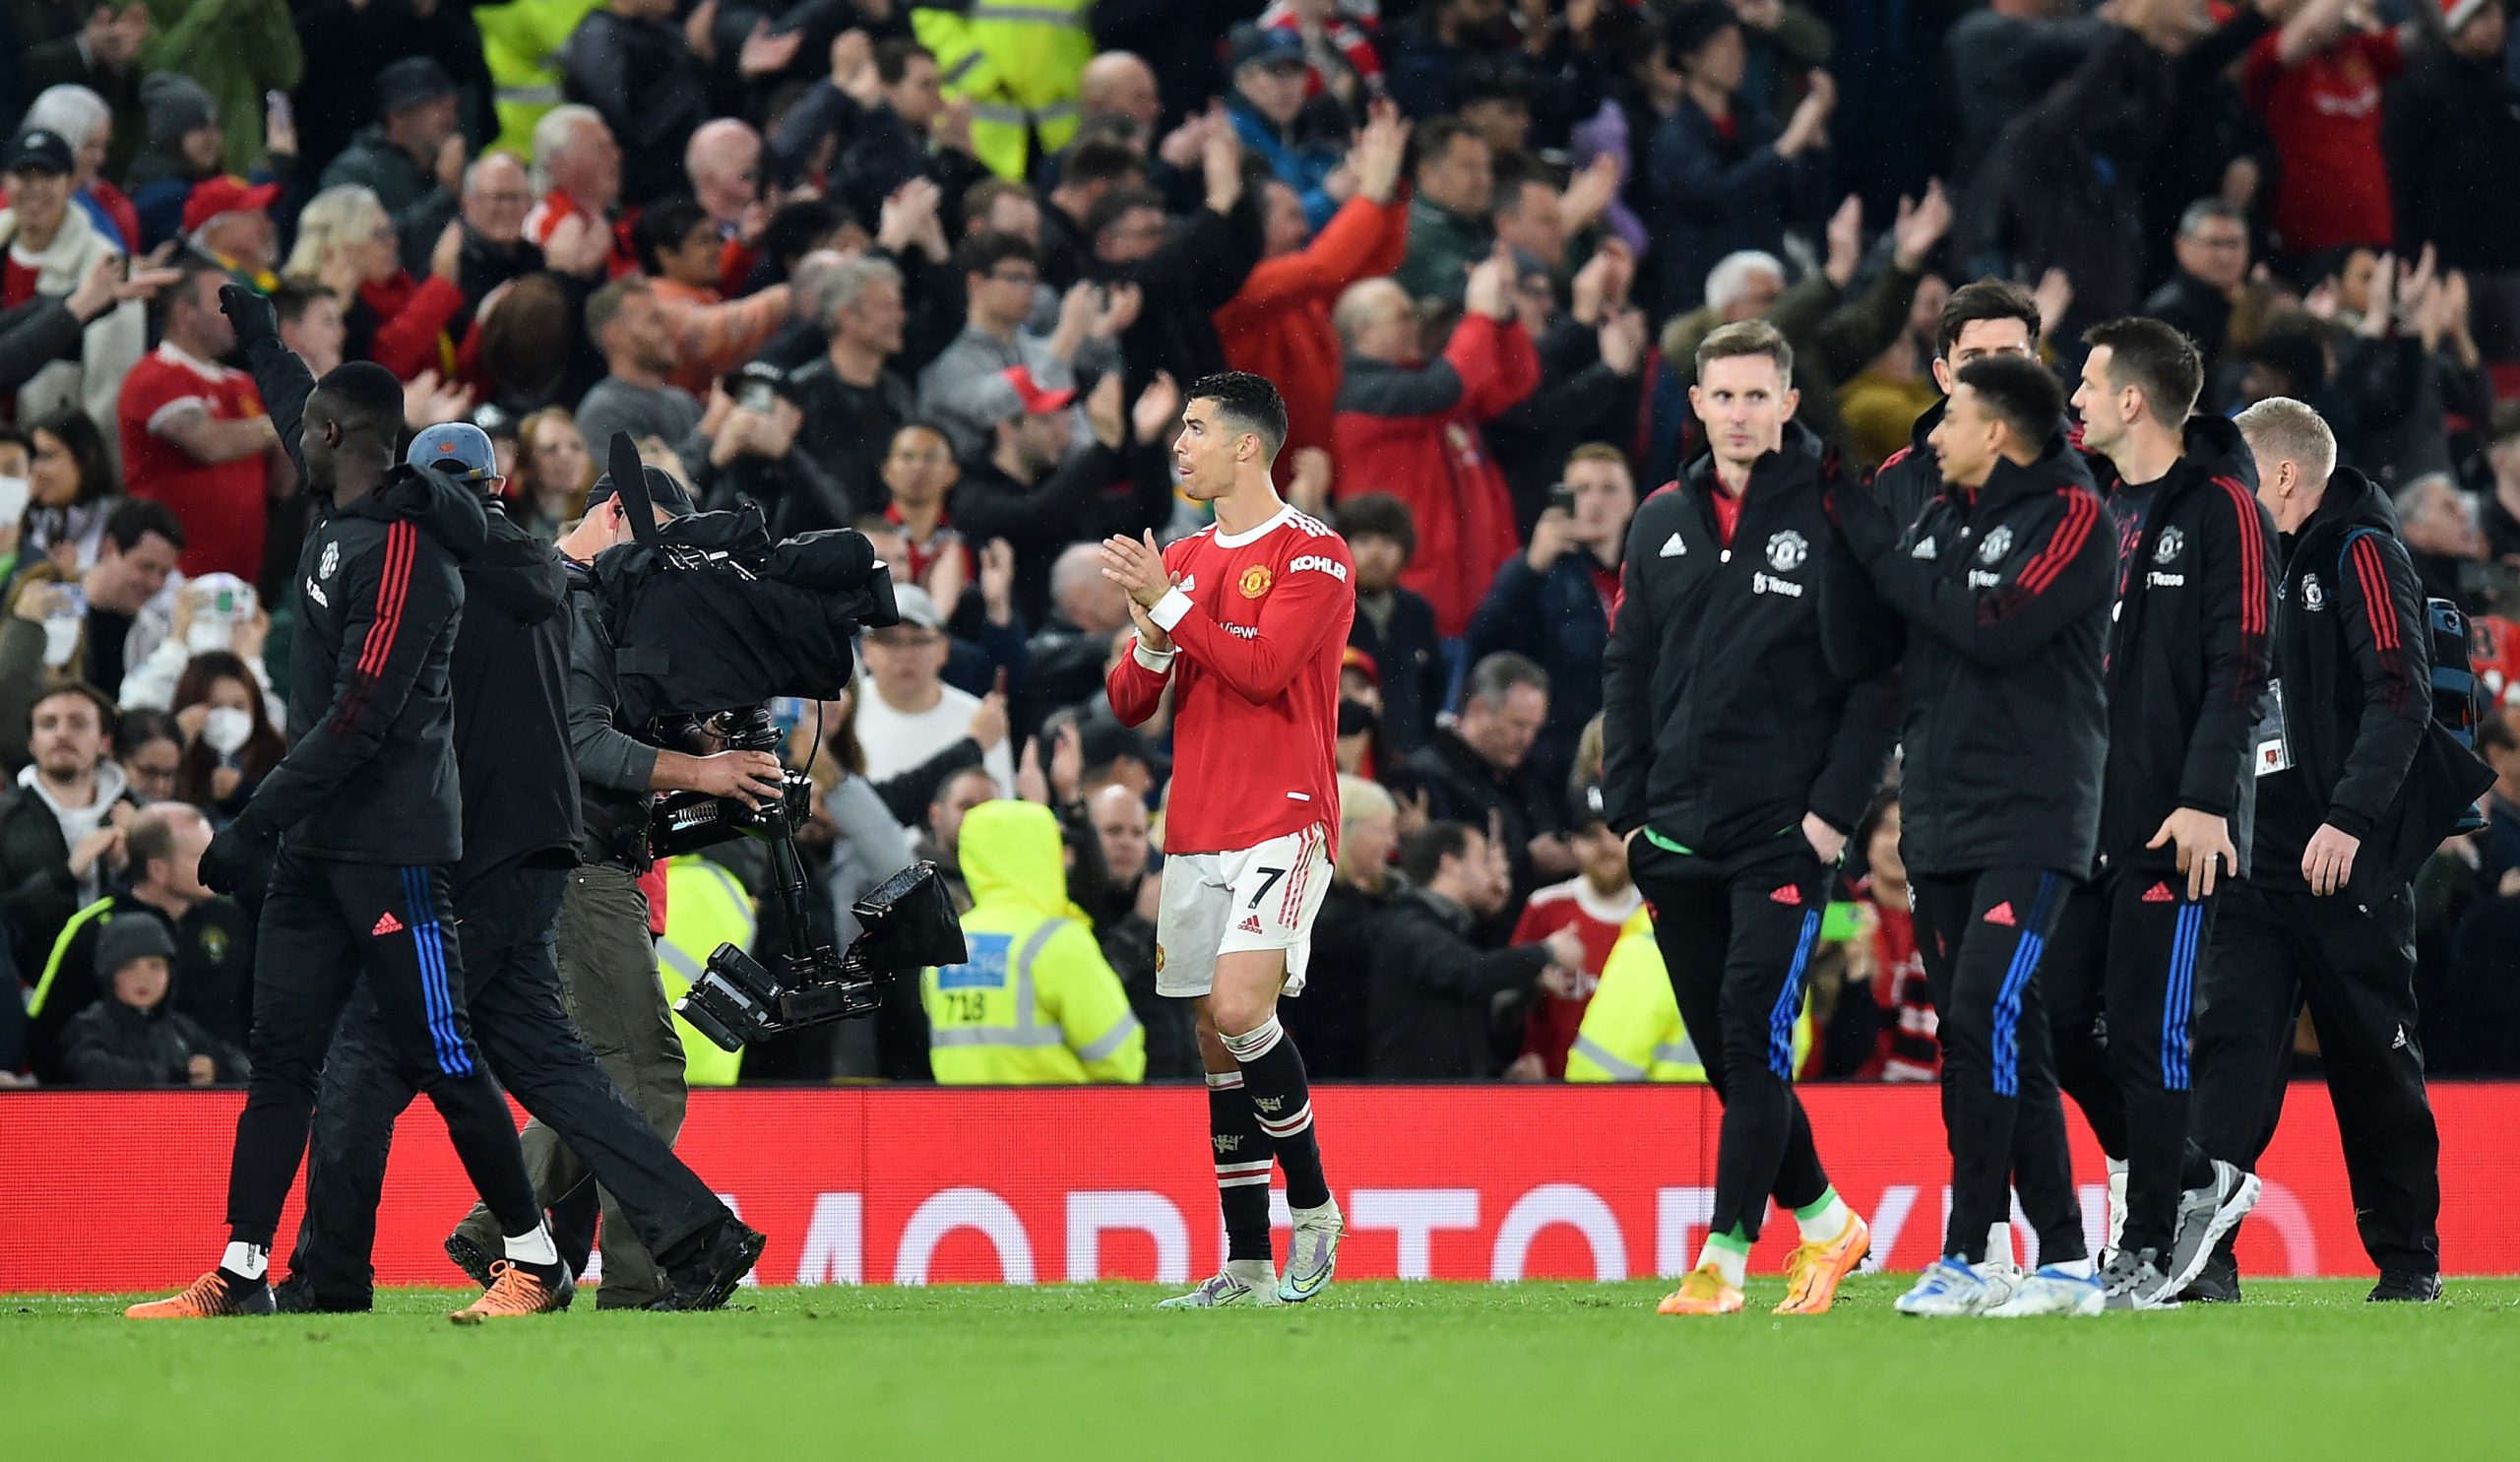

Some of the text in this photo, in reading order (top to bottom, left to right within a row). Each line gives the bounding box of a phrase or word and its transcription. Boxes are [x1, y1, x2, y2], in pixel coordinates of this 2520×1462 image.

[1290, 555, 1348, 583] KOHLER
[1220, 621, 1258, 639] View
[1247, 866, 1288, 910] 7
[1236, 923, 1263, 935] adidas
